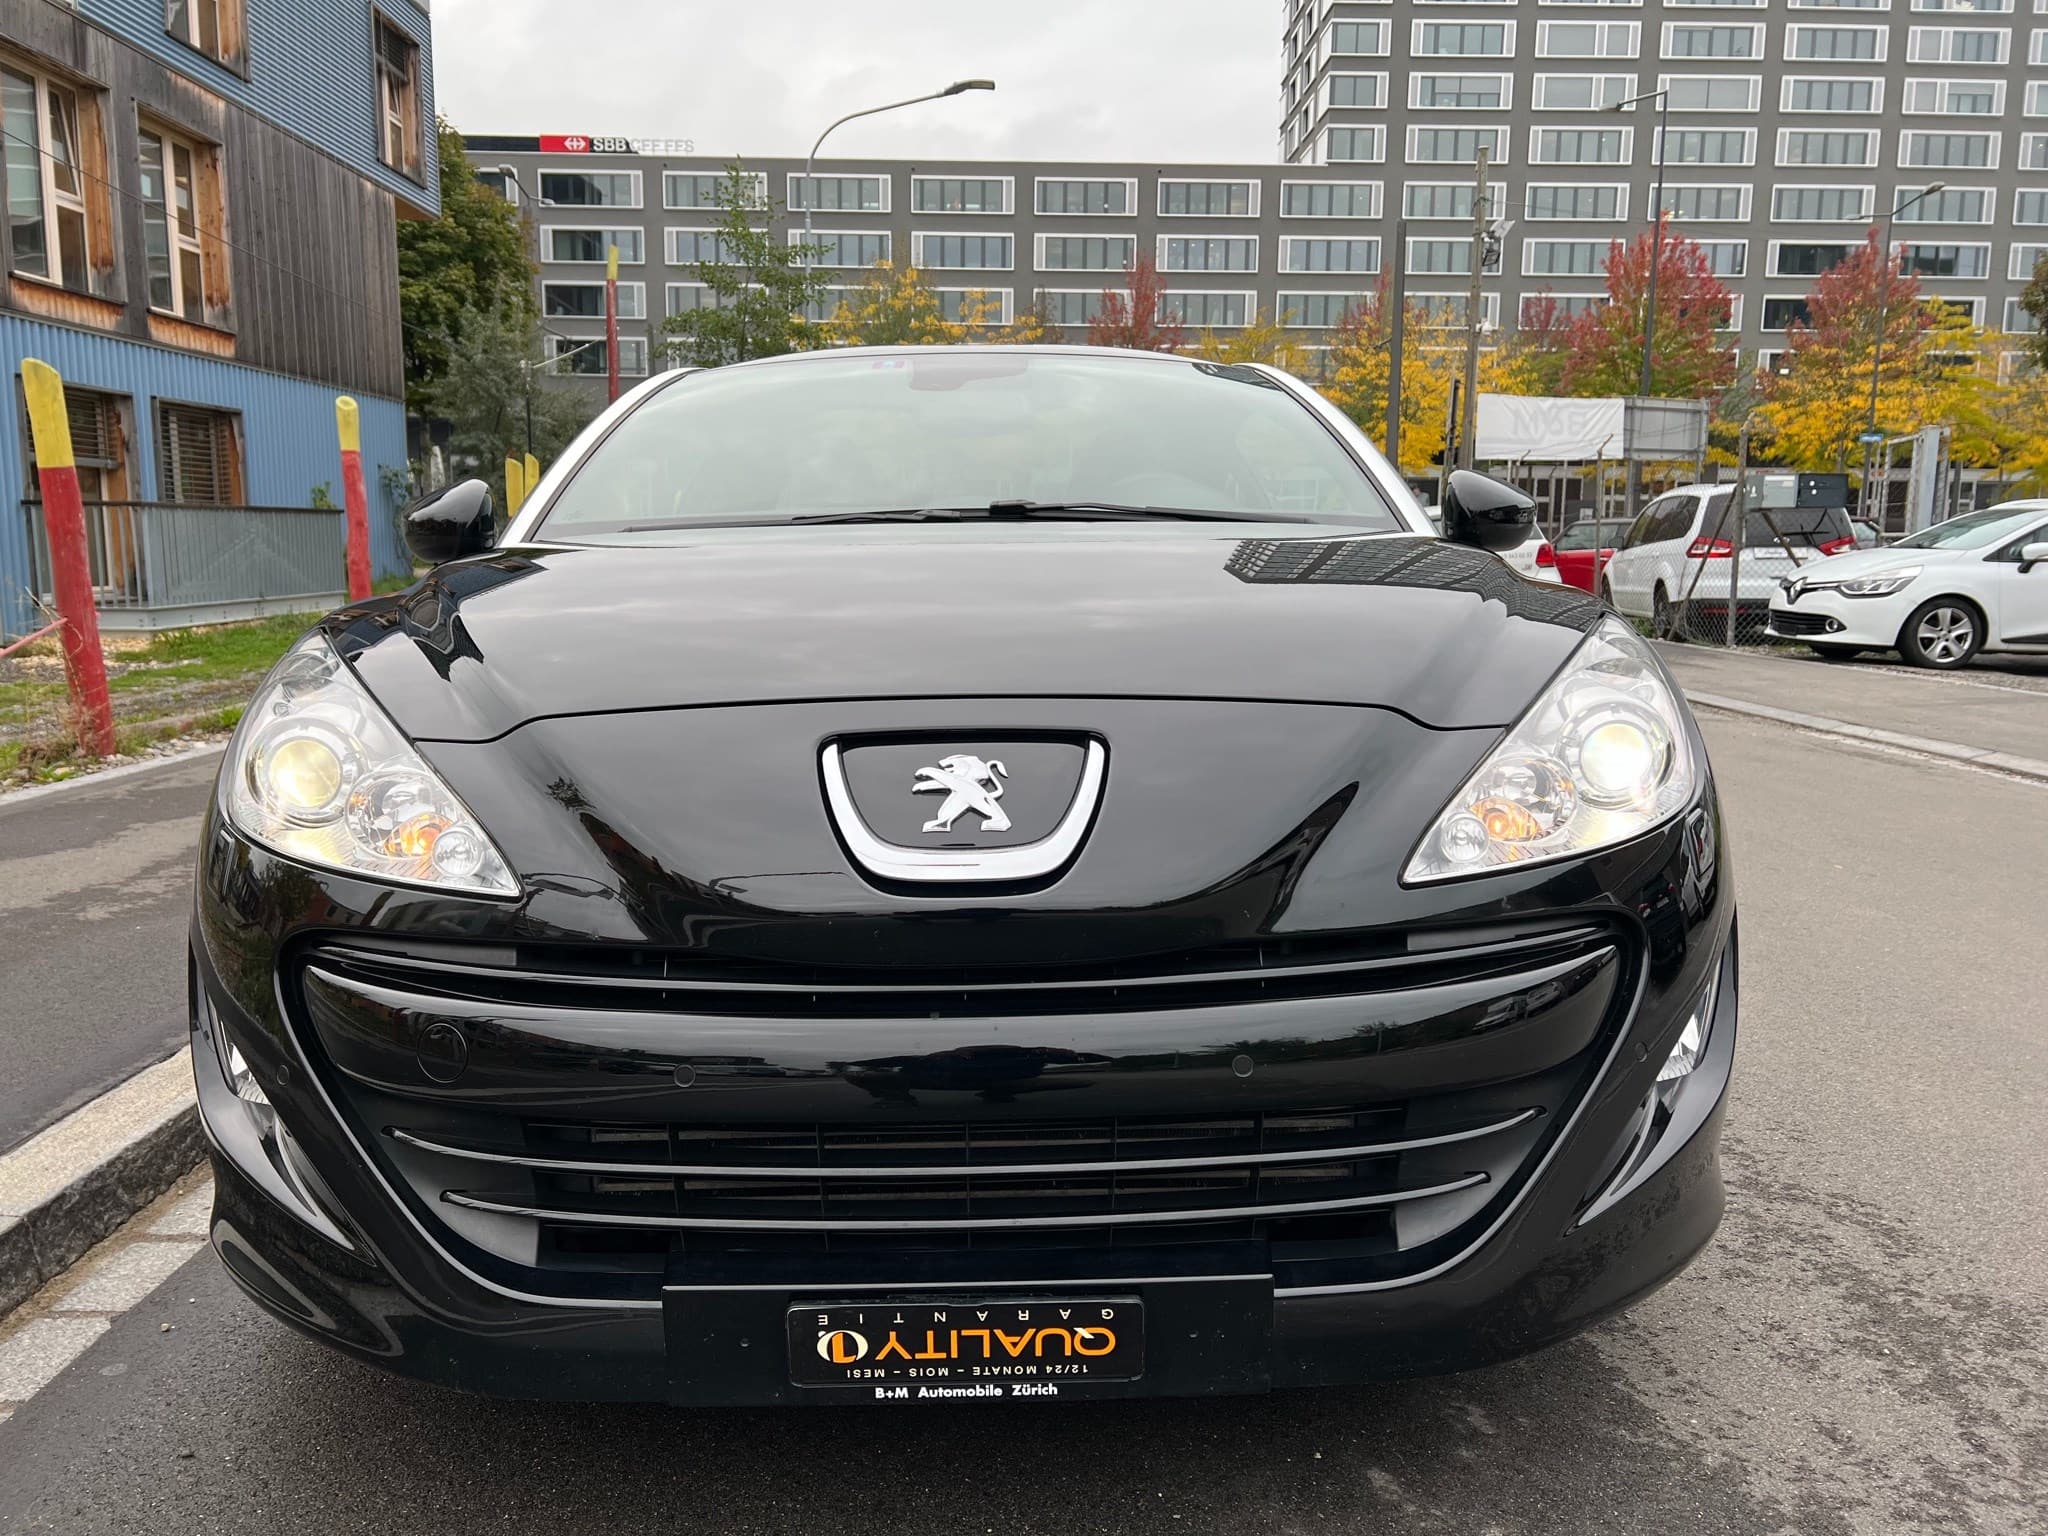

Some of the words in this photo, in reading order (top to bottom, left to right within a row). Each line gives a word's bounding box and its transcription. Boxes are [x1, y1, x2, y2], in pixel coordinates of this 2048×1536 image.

[593, 137, 626, 151] SBB
[664, 139, 695, 153] FFS
[818, 1308, 1114, 1325] GARANTIE
[875, 1327, 1116, 1361] QUALITY
[846, 1368, 885, 1379] MESI
[908, 1367, 949, 1378] MOIS
[972, 1365, 1037, 1376] MONATE
[1045, 1364, 1089, 1374] 12/24
[874, 1386, 909, 1399] B+M
[917, 1384, 1003, 1398] Automobile
[1011, 1382, 1058, 1396] Zürich
